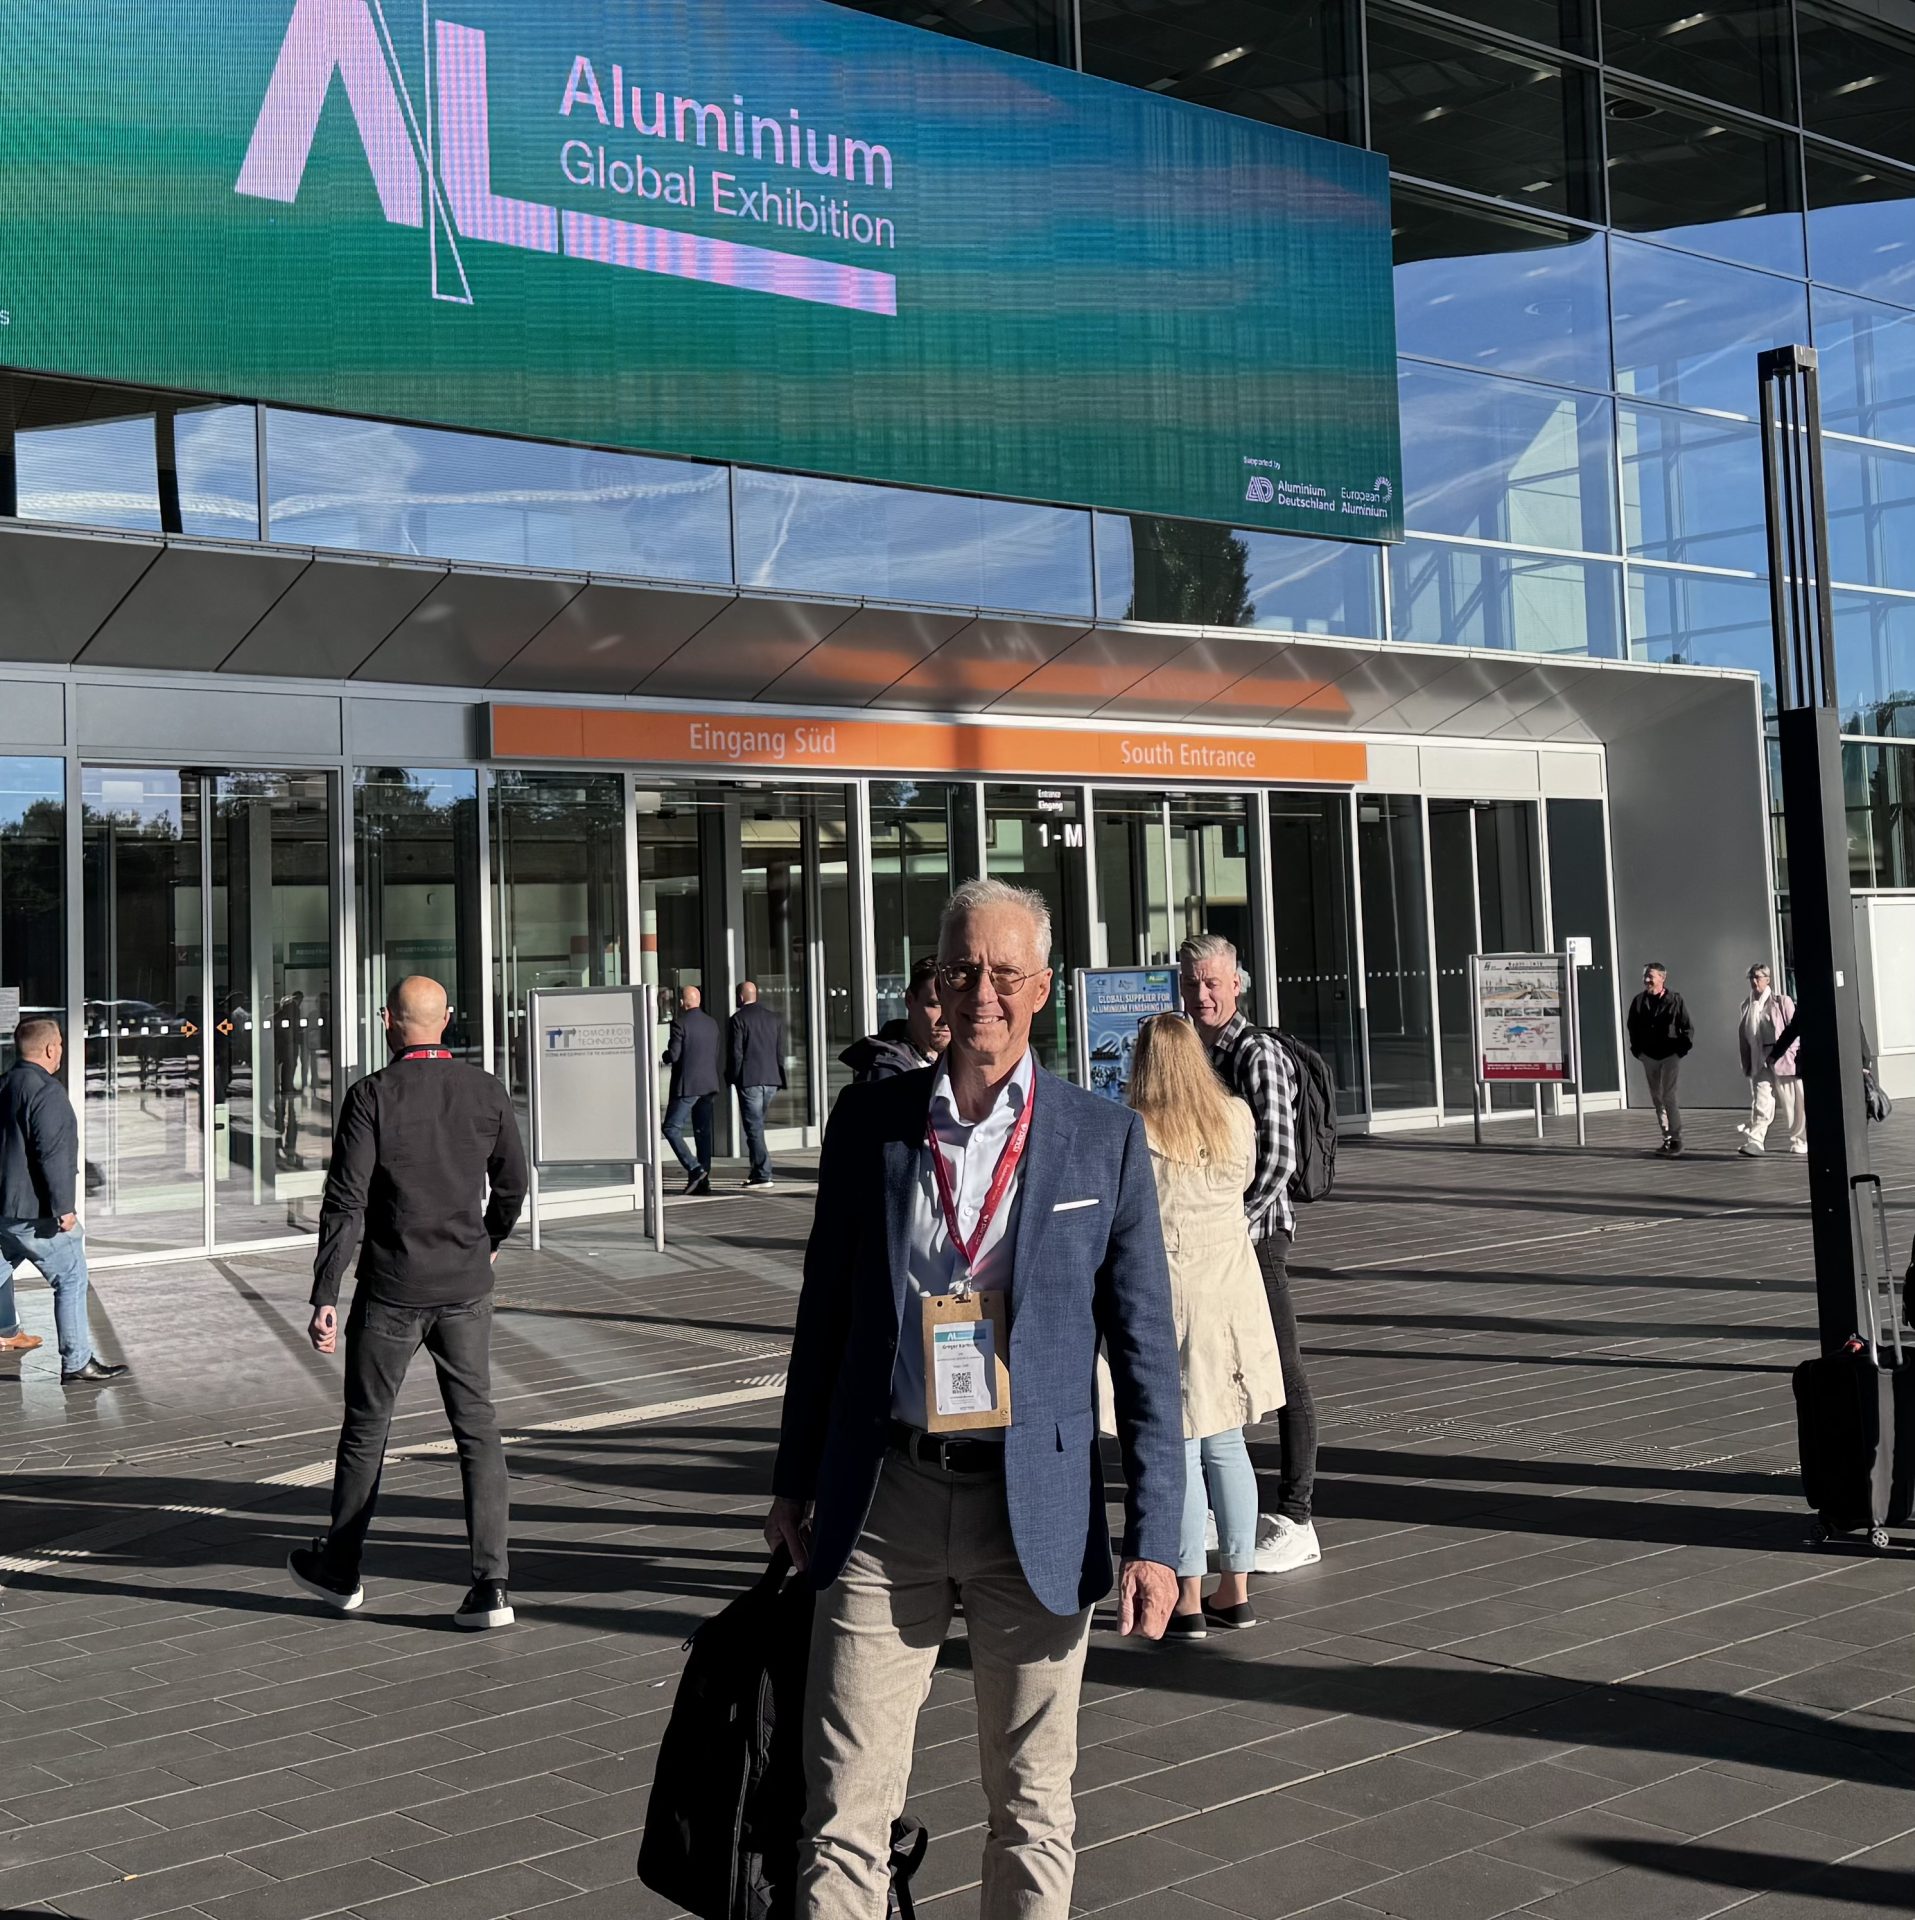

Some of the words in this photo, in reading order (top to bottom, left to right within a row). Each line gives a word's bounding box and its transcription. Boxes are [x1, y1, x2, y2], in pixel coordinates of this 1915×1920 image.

[559, 55, 894, 190] Aluminium
[560, 139, 697, 208] Global
[712, 171, 896, 249] Exhibition
[1278, 480, 1327, 497] Aluminium
[1341, 487, 1380, 503] European
[1278, 494, 1336, 512] Deutschland
[1341, 502, 1388, 518] Aluminium
[689, 723, 786, 760] Eingang
[794, 727, 836, 754] Süd
[1121, 740, 1174, 765] South
[1180, 743, 1257, 768] Entrance
[1038, 800, 1064, 812] Eingang
[578, 1037, 632, 1046] TECHNOLOGY
